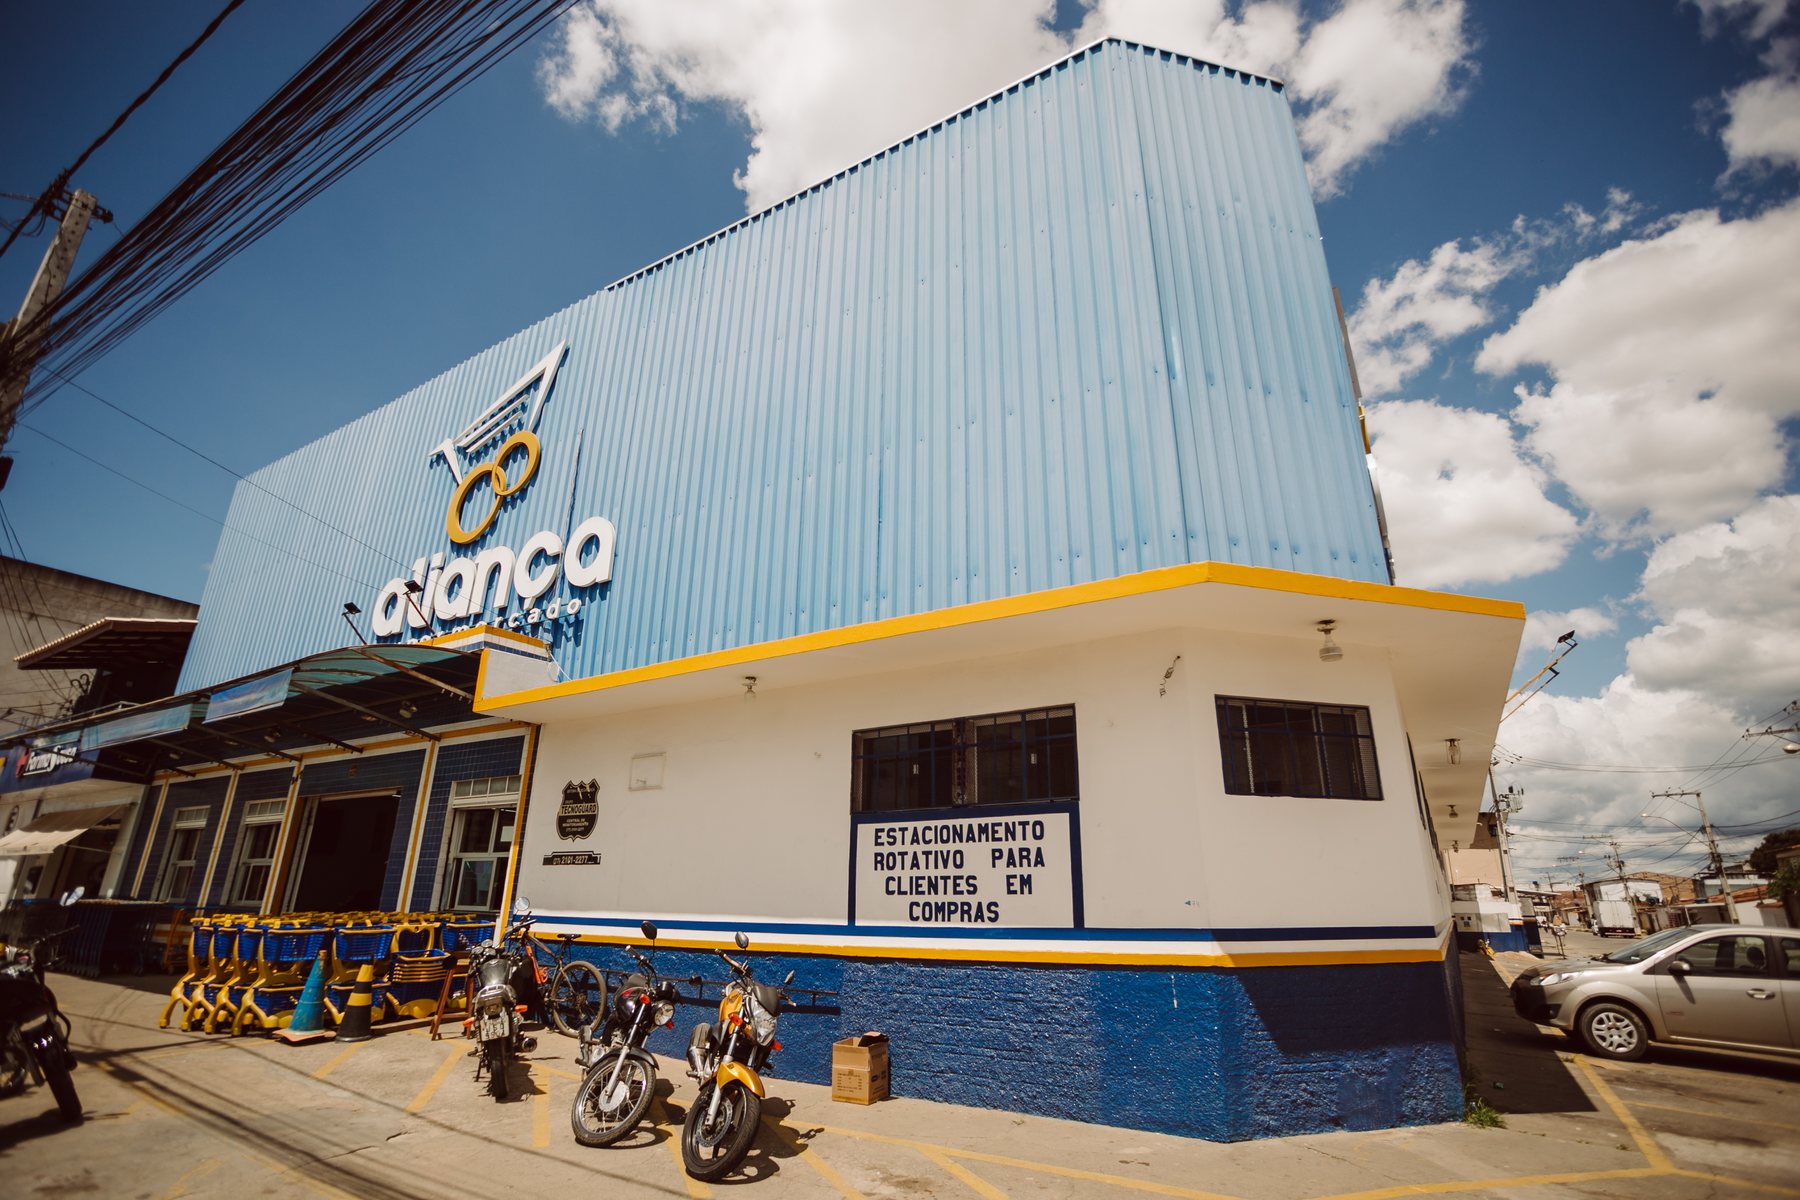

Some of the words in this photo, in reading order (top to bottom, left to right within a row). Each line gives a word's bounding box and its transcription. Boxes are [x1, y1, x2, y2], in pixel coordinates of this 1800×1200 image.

[372, 516, 616, 637] aliança
[561, 804, 596, 814] TECNOGUARD
[874, 820, 1045, 846] ESTACIONAMENTO
[874, 849, 965, 871] ROTATIVO
[991, 847, 1045, 869] PARA
[885, 875, 978, 896] CLIENTES
[1006, 873, 1033, 895] EM
[909, 901, 1000, 923] COMPRAS
